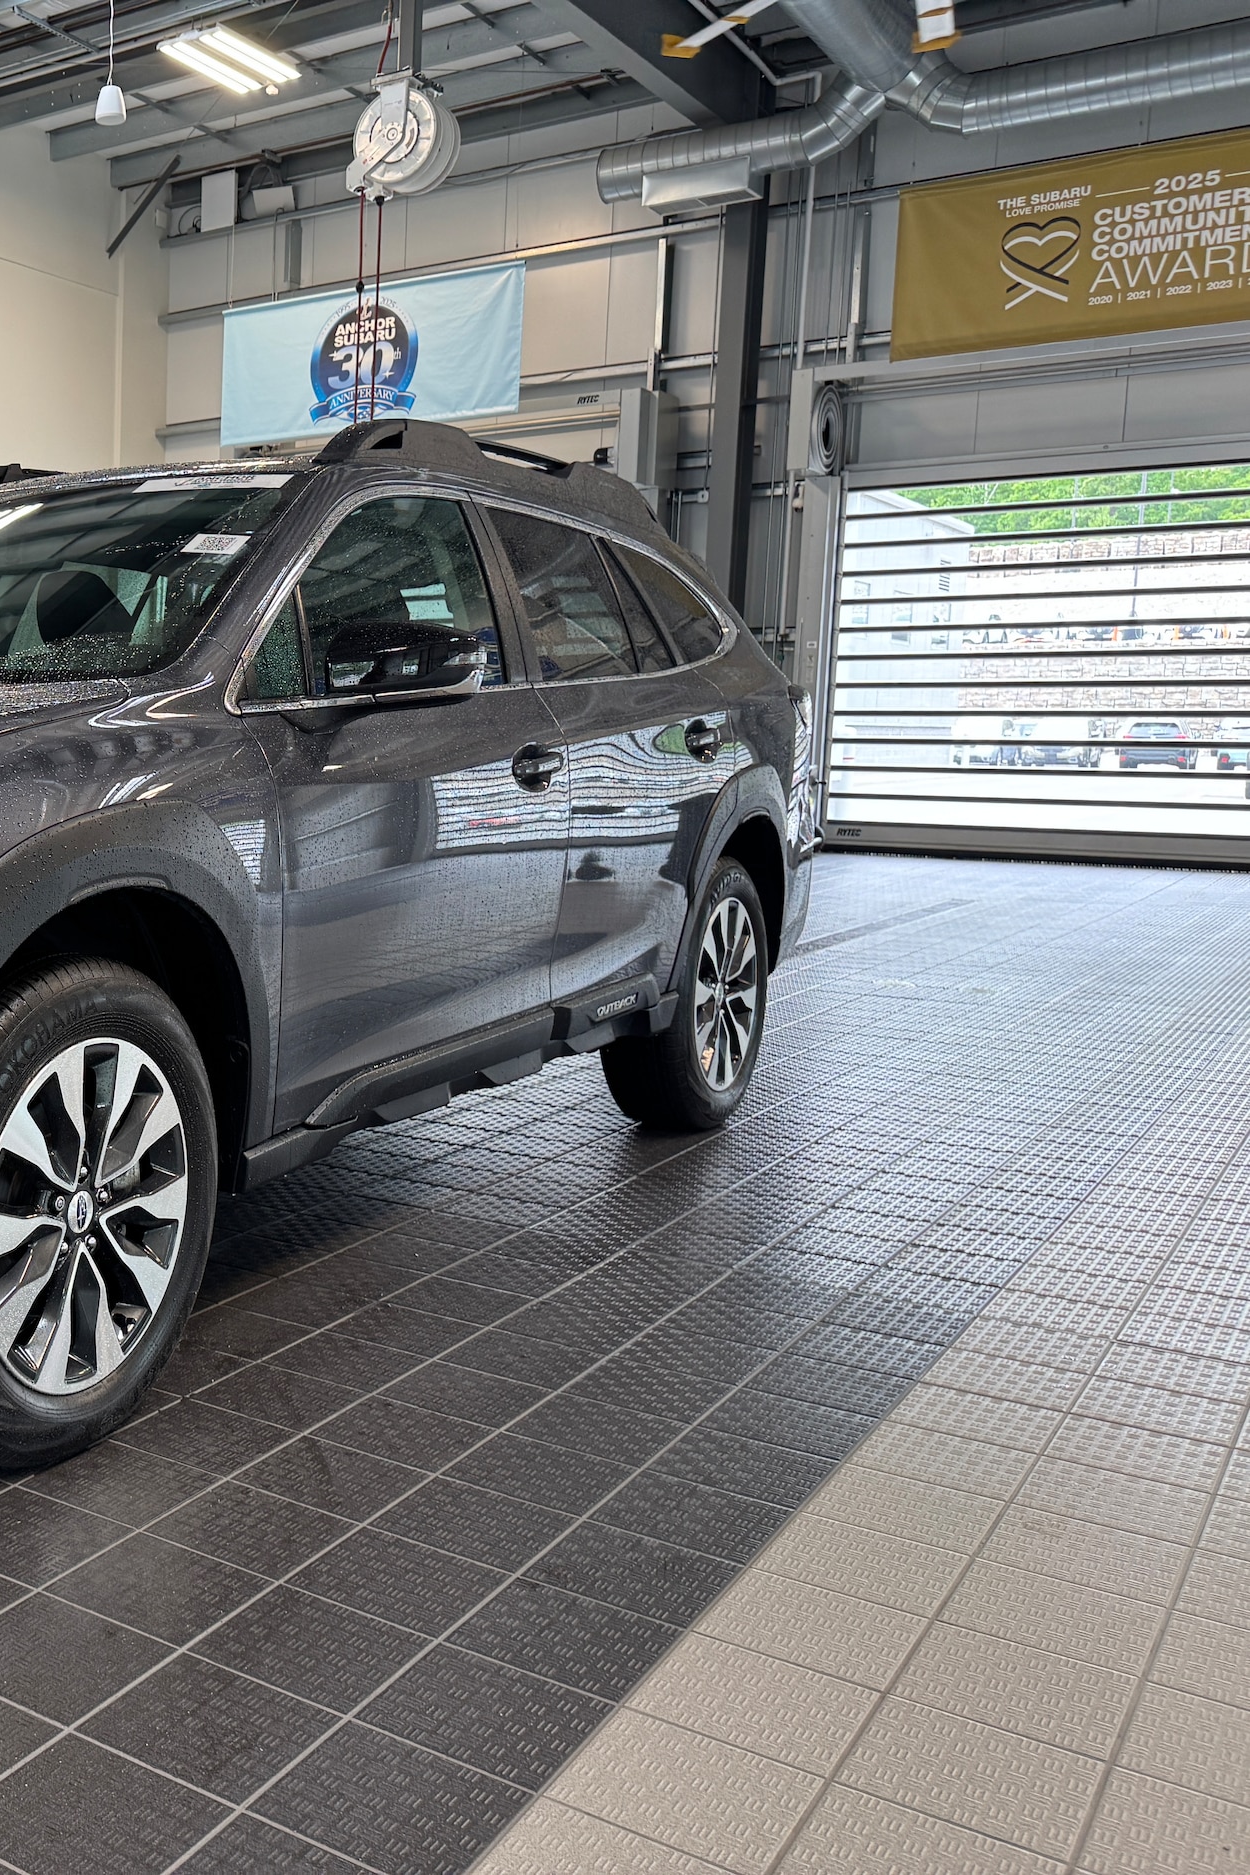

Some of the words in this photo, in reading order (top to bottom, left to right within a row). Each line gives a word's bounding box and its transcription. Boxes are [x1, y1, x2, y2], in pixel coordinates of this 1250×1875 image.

[1153, 169, 1221, 195] 2025
[997, 196, 1027, 210] THE
[1030, 185, 1092, 205] SUBARU
[1005, 206, 1032, 218] LOVE
[1034, 198, 1081, 213] PROMISE
[1093, 186, 1250, 226] CUSTOMER
[1089, 241, 1250, 294] AWAR
[1088, 295, 1113, 306] 2020
[1126, 290, 1151, 301] 2021
[1166, 284, 1192, 296] 2022
[1206, 279, 1233, 291] 2023
[333, 327, 396, 349] SUBARU
[334, 316, 396, 337] ANCHOR
[576, 394, 600, 405] RYTEC
[836, 827, 862, 837] RYTEC
[596, 993, 637, 1018] OUTBACK
